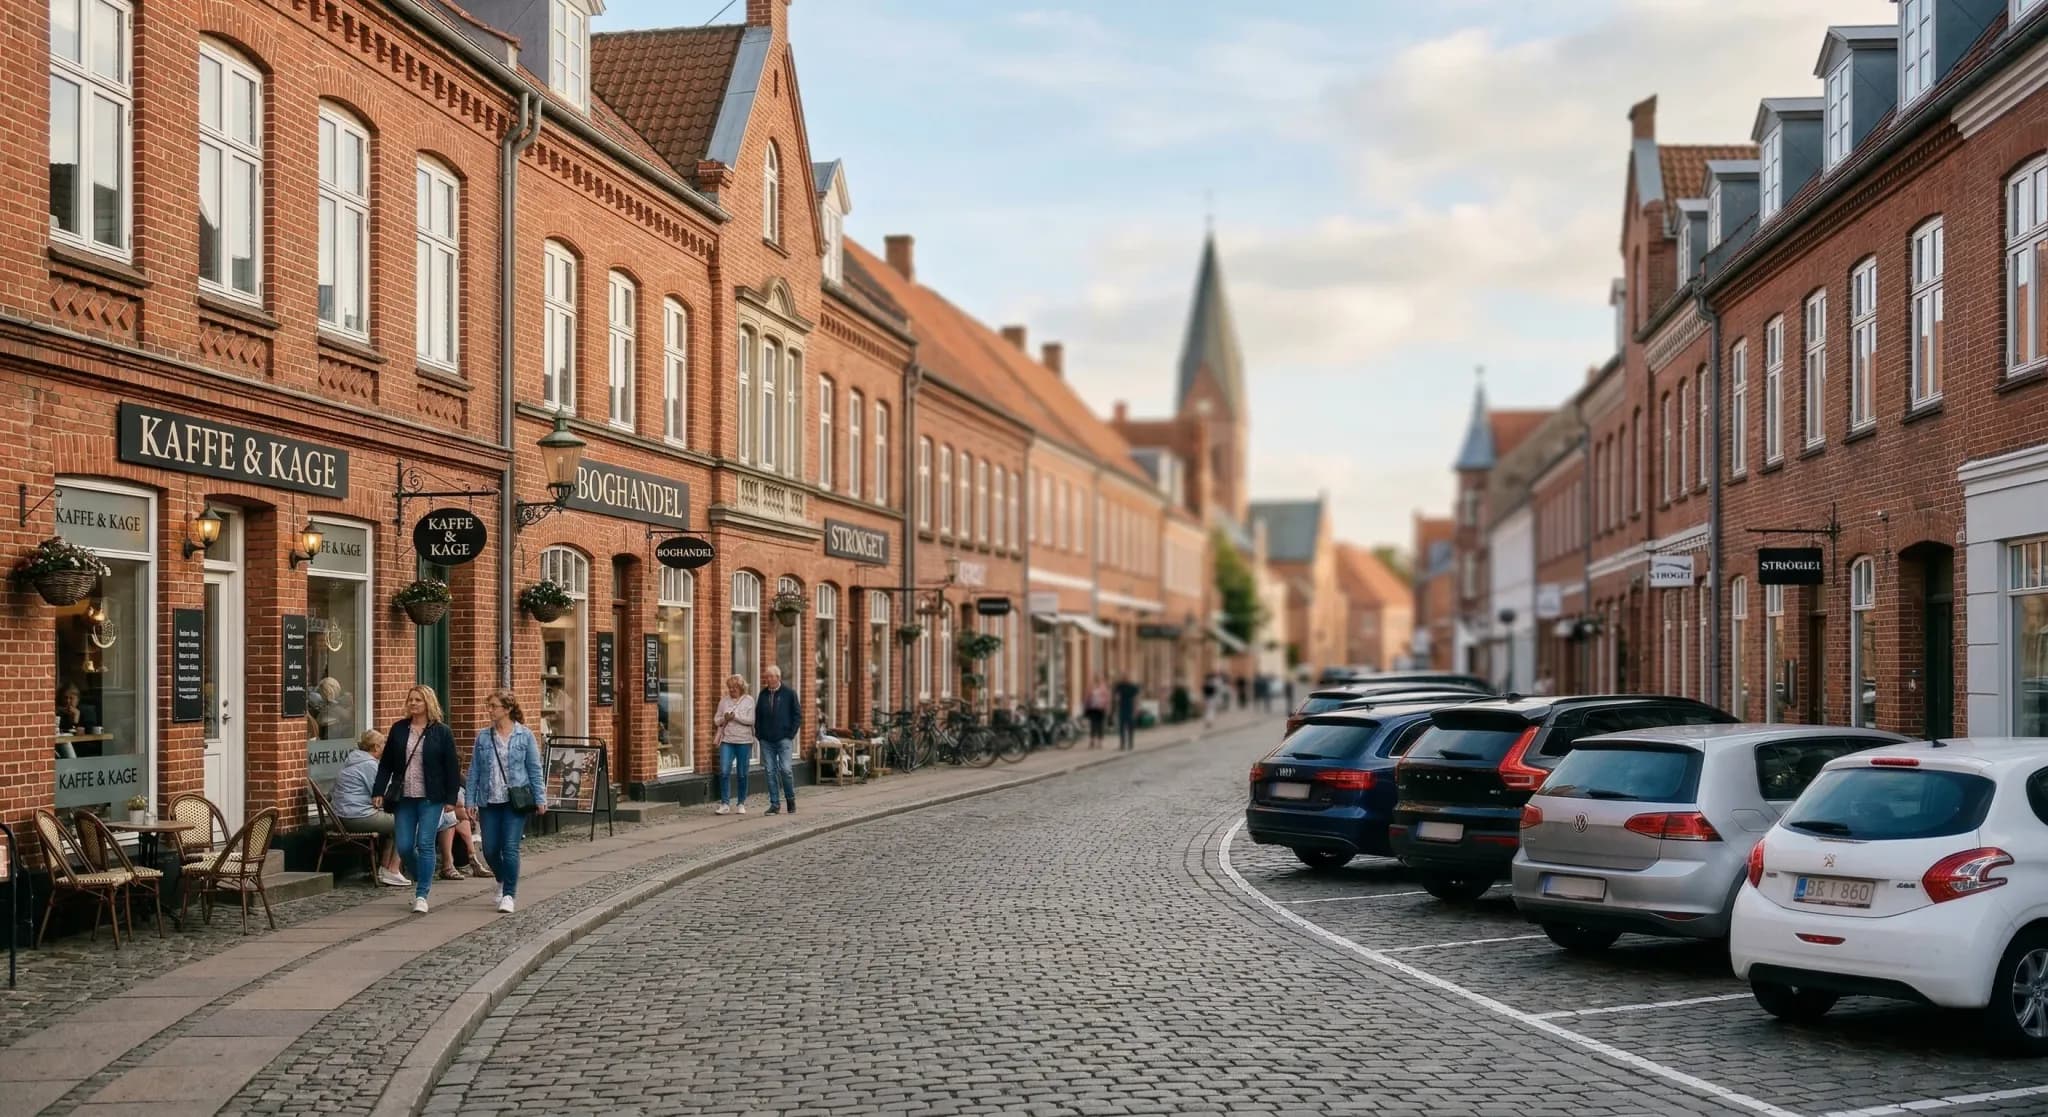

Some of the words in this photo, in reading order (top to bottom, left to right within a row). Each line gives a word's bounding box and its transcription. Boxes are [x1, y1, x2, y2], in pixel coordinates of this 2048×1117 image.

[139, 414, 235, 471] KAFFE
[243, 437, 263, 476] &
[269, 441, 337, 489] KAGE
[577, 466, 683, 518] BOGHANDEL
[56, 507, 95, 527] KAFFE
[97, 512, 106, 528] &
[109, 513, 141, 532] KAGE
[428, 517, 474, 530] KAFFE
[444, 530, 457, 543] &
[430, 543, 471, 556] KAGE
[657, 548, 713, 558] BOGHANDEL
[339, 748, 354, 762] KA
[59, 771, 94, 790] KAFFE
[97, 770, 105, 786] &
[108, 767, 137, 785] KAGE
[1840, 883, 1868, 901] 860
